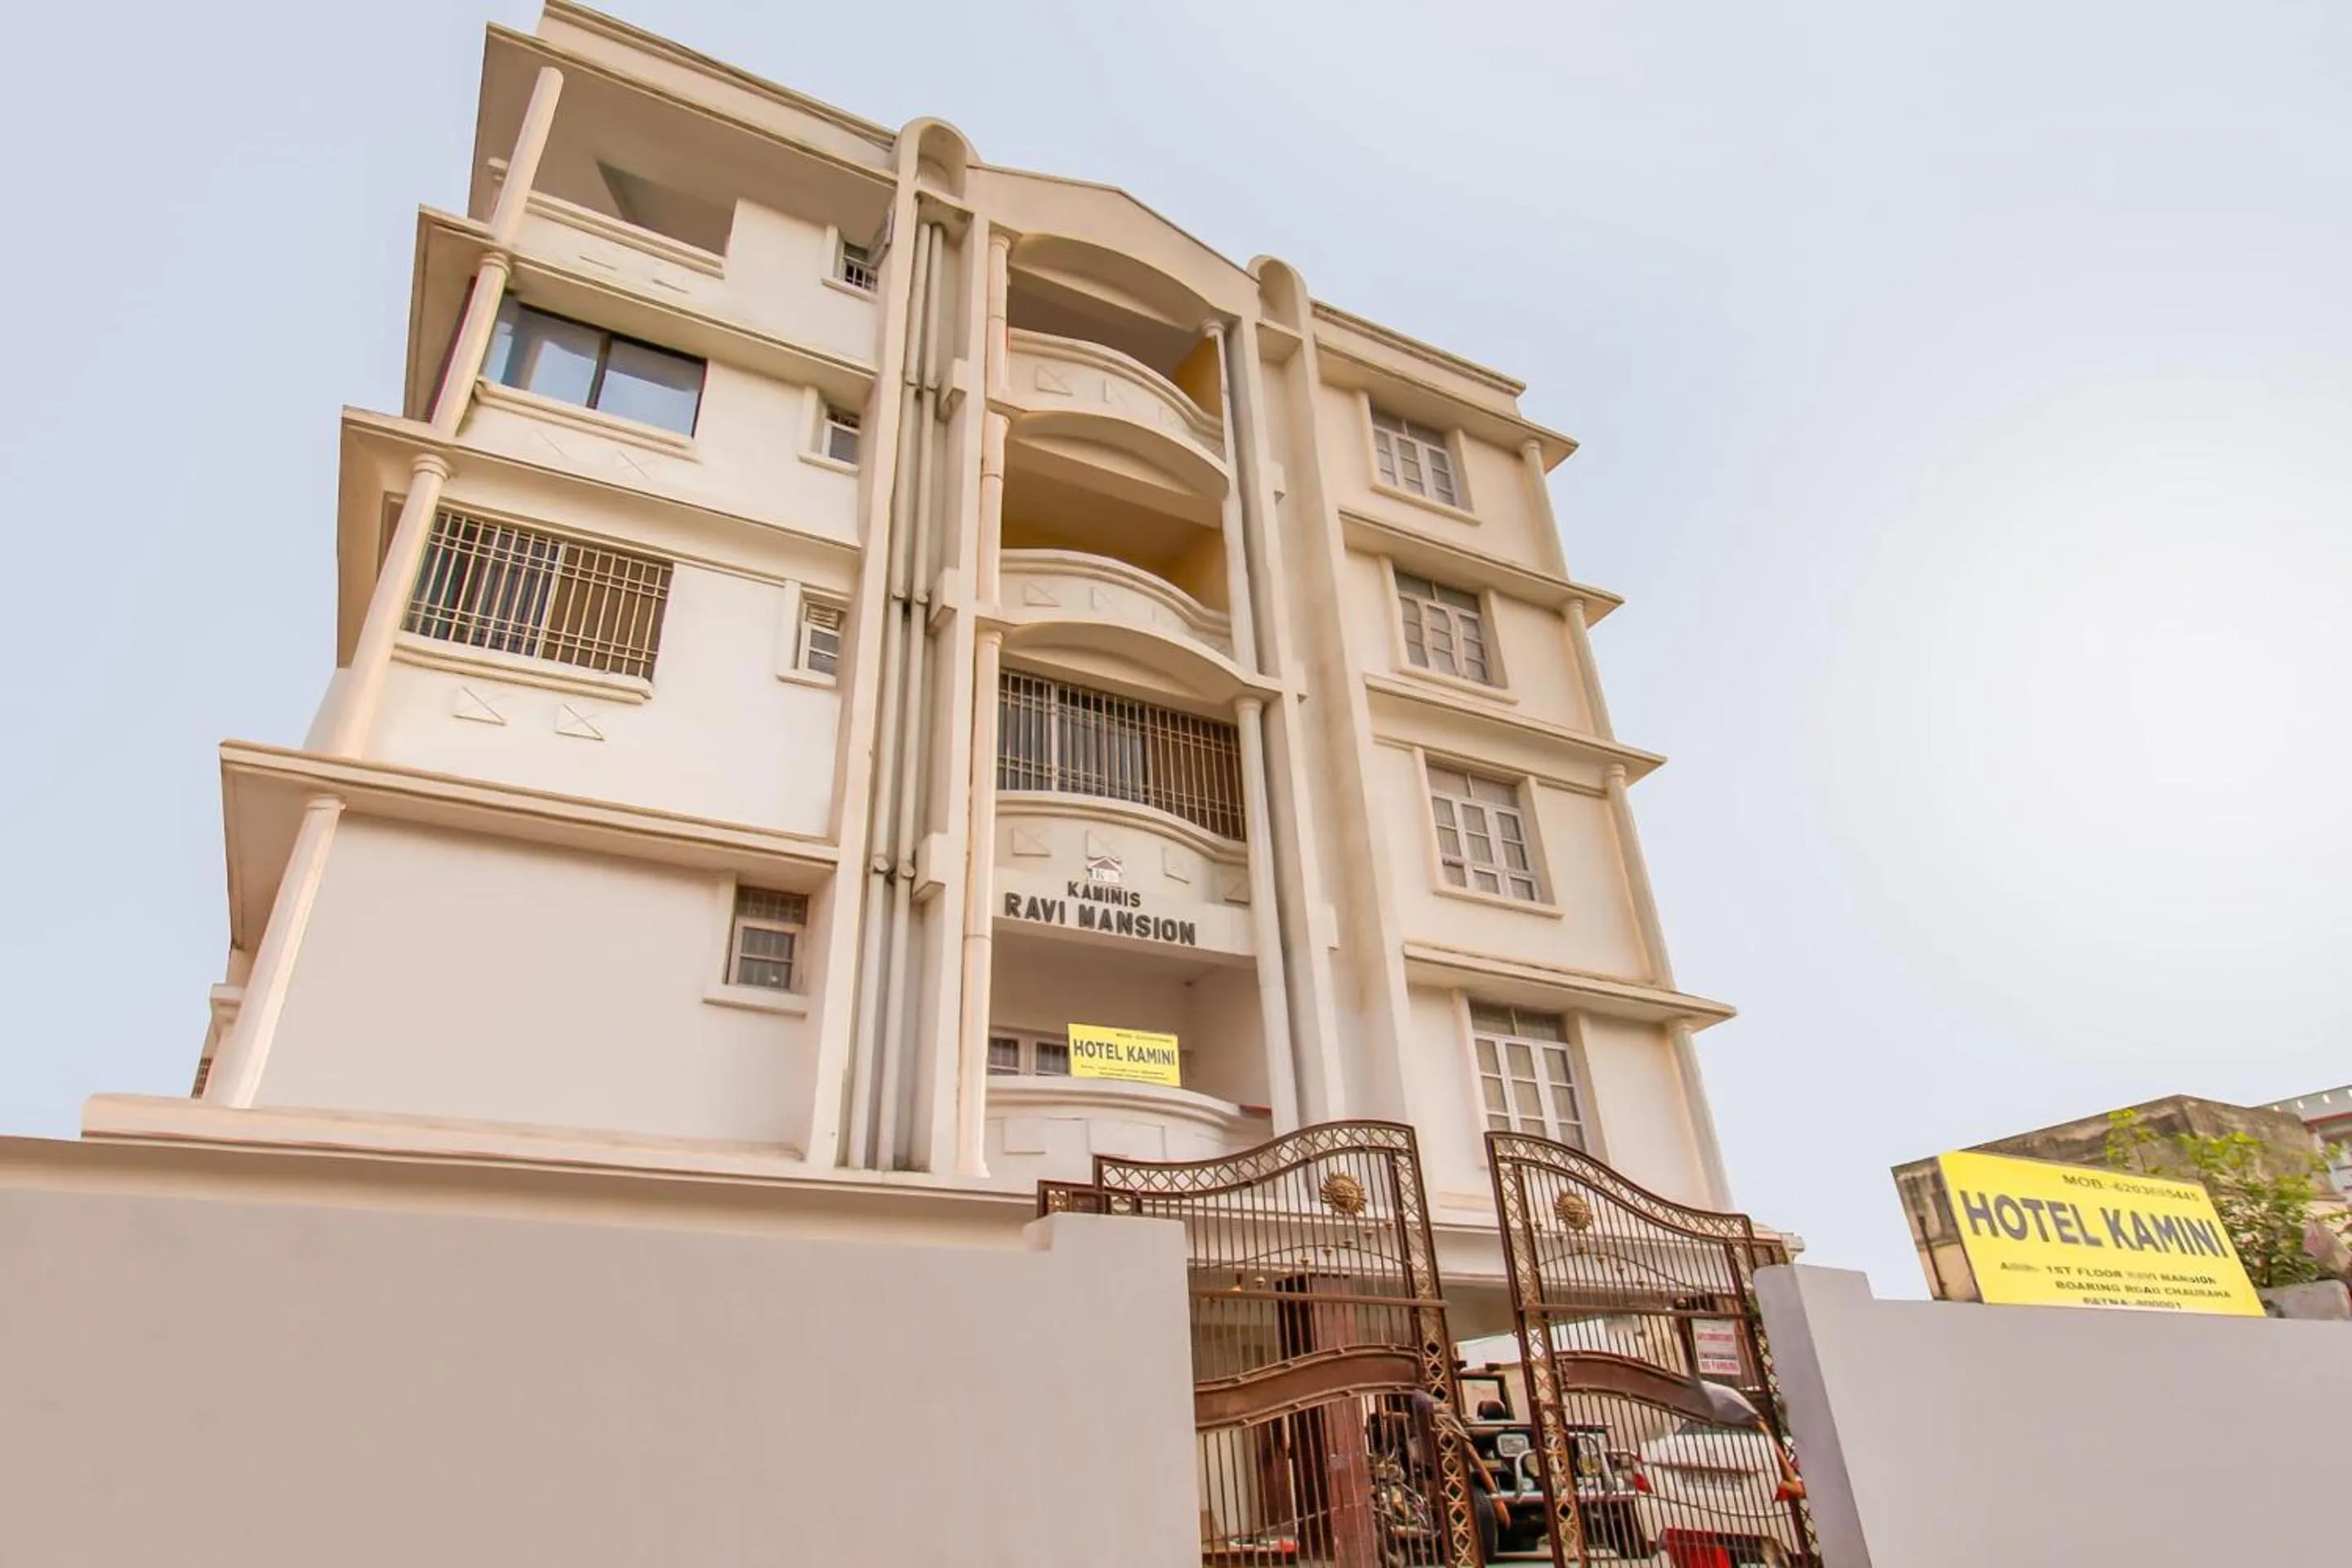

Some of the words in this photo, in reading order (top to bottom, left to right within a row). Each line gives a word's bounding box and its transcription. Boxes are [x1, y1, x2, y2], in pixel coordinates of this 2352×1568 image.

[1067, 880, 1141, 908] KAMINIS
[1004, 892, 1066, 924] RAVI
[1078, 904, 1196, 946] MANSION
[1073, 1038, 1123, 1062] HOTEL
[1127, 1045, 1175, 1067] KAMINI
[1959, 1190, 2105, 1248] HOTEL
[2100, 1207, 2230, 1258] KAMINI
[2046, 1265, 2072, 1275] 1ST
[2077, 1267, 2123, 1278] FLOOR
